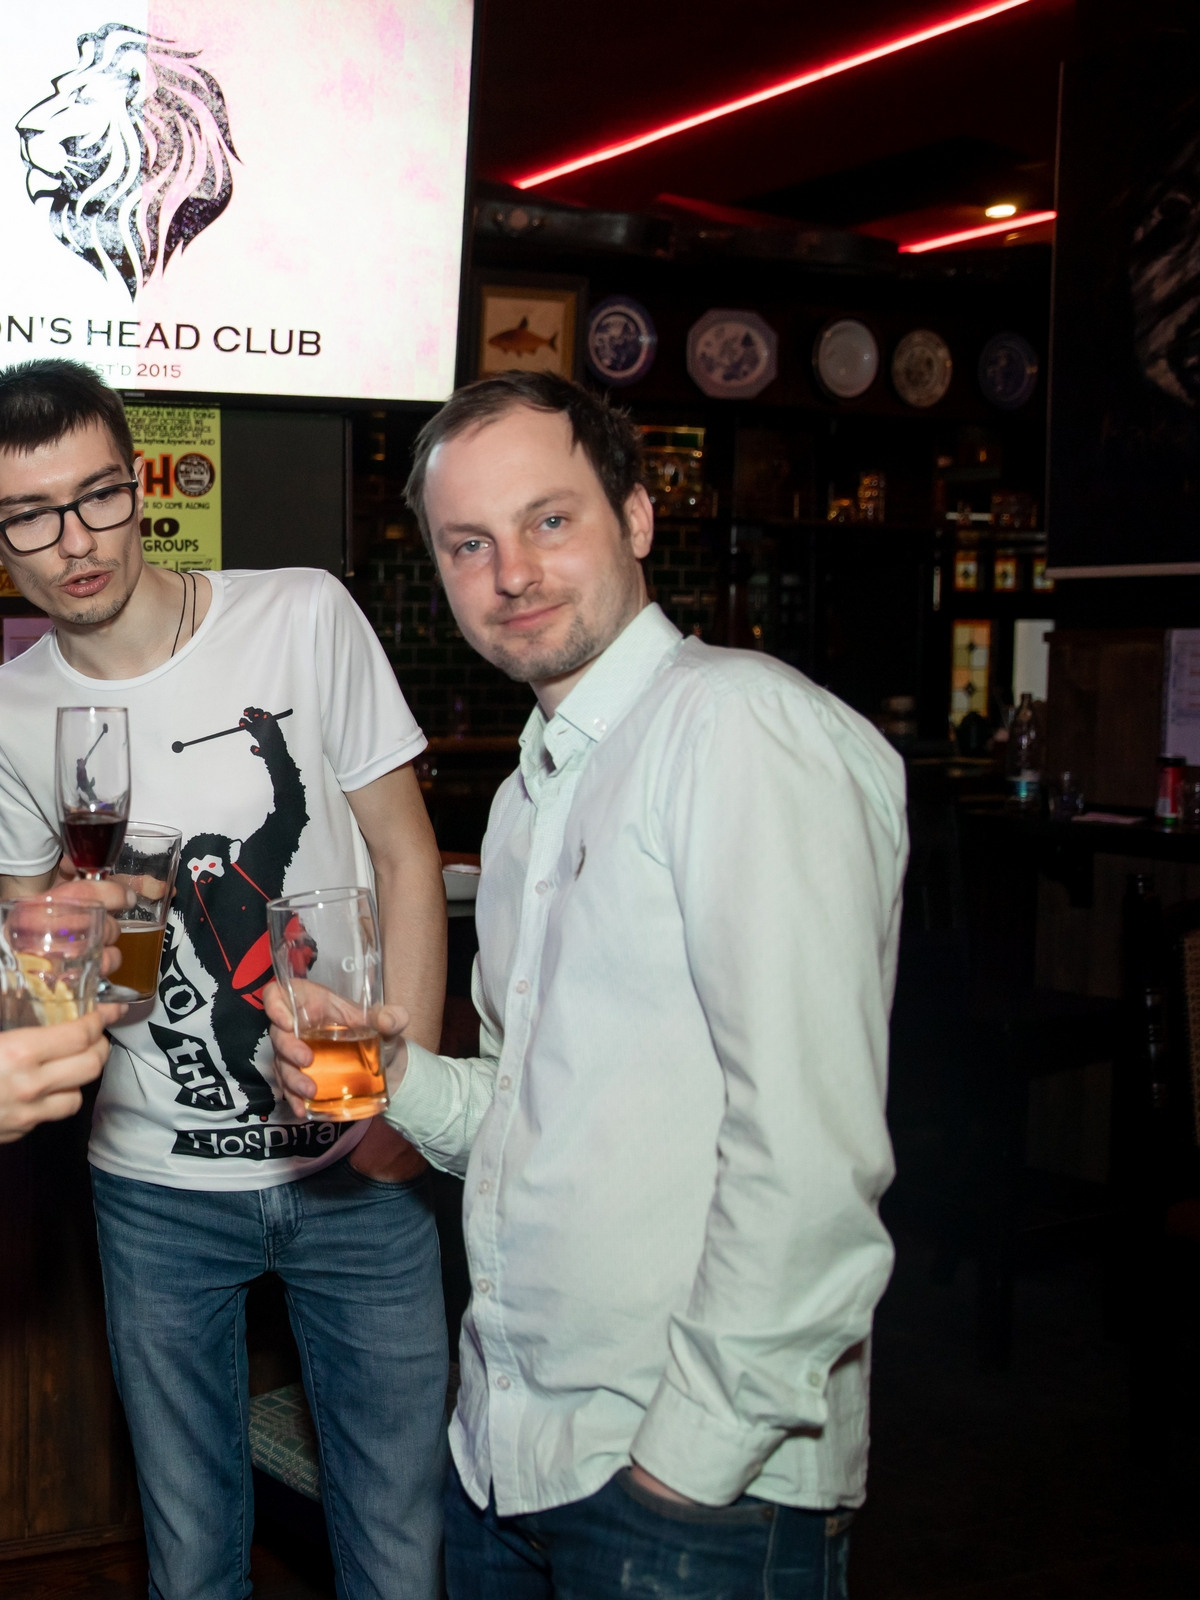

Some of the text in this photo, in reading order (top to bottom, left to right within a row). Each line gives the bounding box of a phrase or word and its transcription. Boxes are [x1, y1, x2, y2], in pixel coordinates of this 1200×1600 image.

[87, 319, 201, 351] HEAD
[213, 325, 322, 356] CLUB
[137, 363, 182, 378] 2015
[185, 502, 210, 510] ALONG
[143, 540, 199, 552] GROUPS
